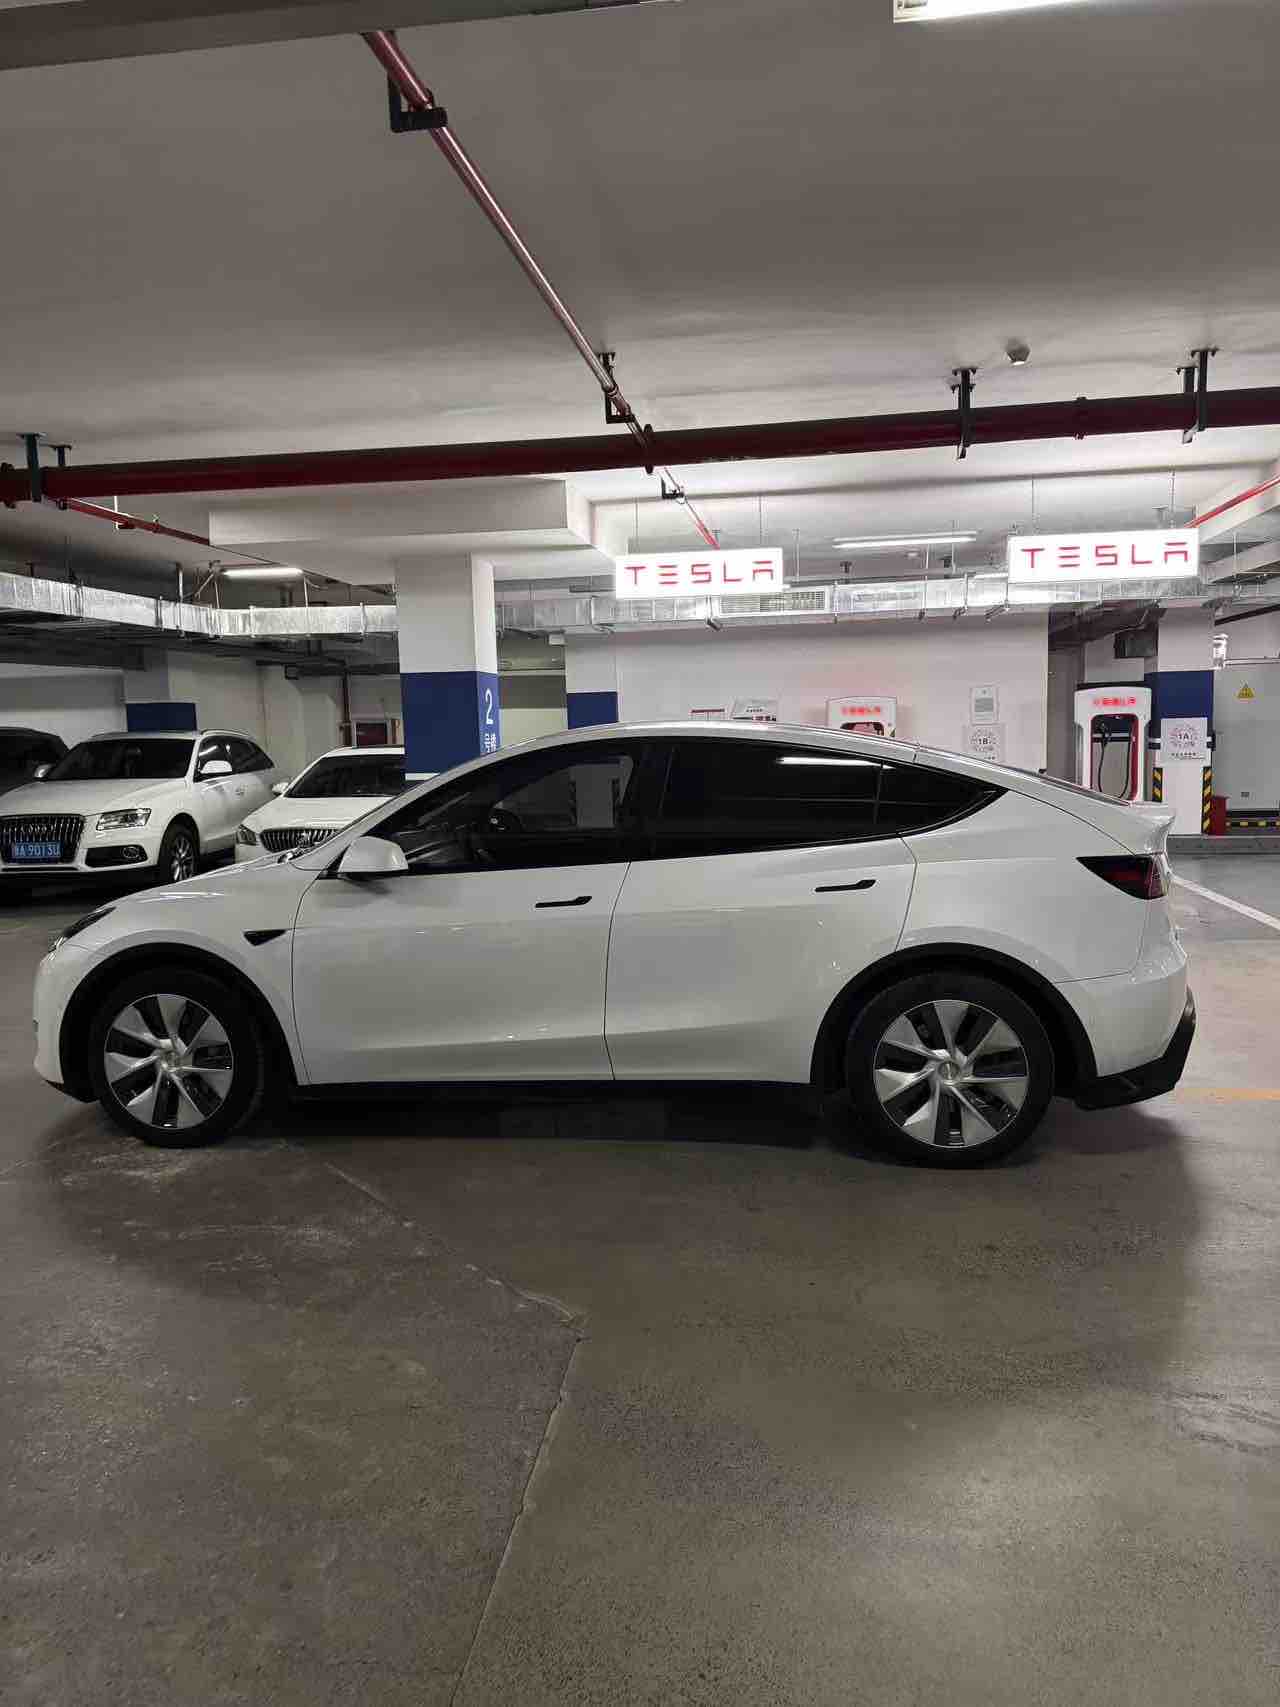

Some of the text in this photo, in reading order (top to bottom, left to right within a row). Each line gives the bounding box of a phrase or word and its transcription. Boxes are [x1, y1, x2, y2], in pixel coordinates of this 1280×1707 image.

[1020, 541, 1189, 569] TESLA
[624, 559, 774, 585] TESLA
[485, 687, 494, 725] 2
